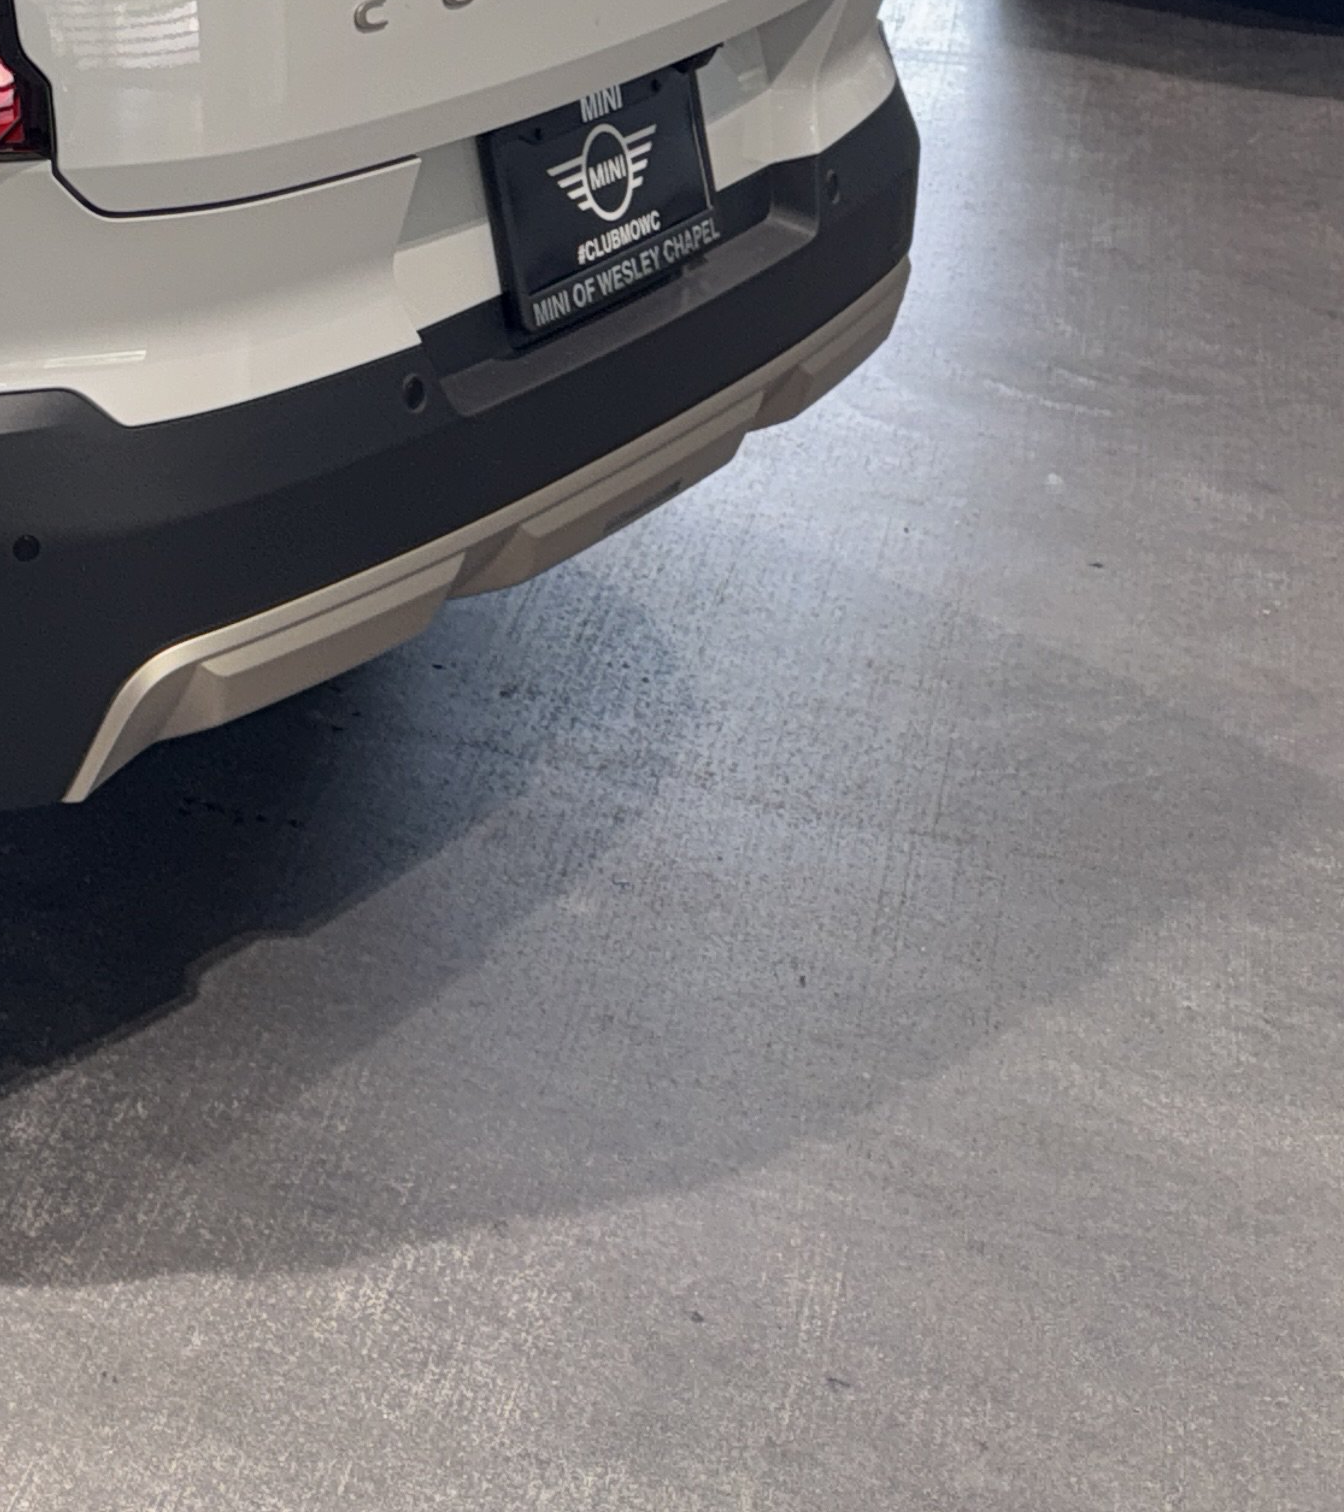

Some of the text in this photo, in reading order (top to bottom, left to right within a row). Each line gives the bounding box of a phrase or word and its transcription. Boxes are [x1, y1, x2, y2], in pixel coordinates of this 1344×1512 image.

[579, 84, 624, 123] MINI
[588, 154, 628, 191] MINI
[577, 210, 662, 265] #CLUBMOWC
[532, 217, 721, 327] MINI OF WESLEY CHAPEL
